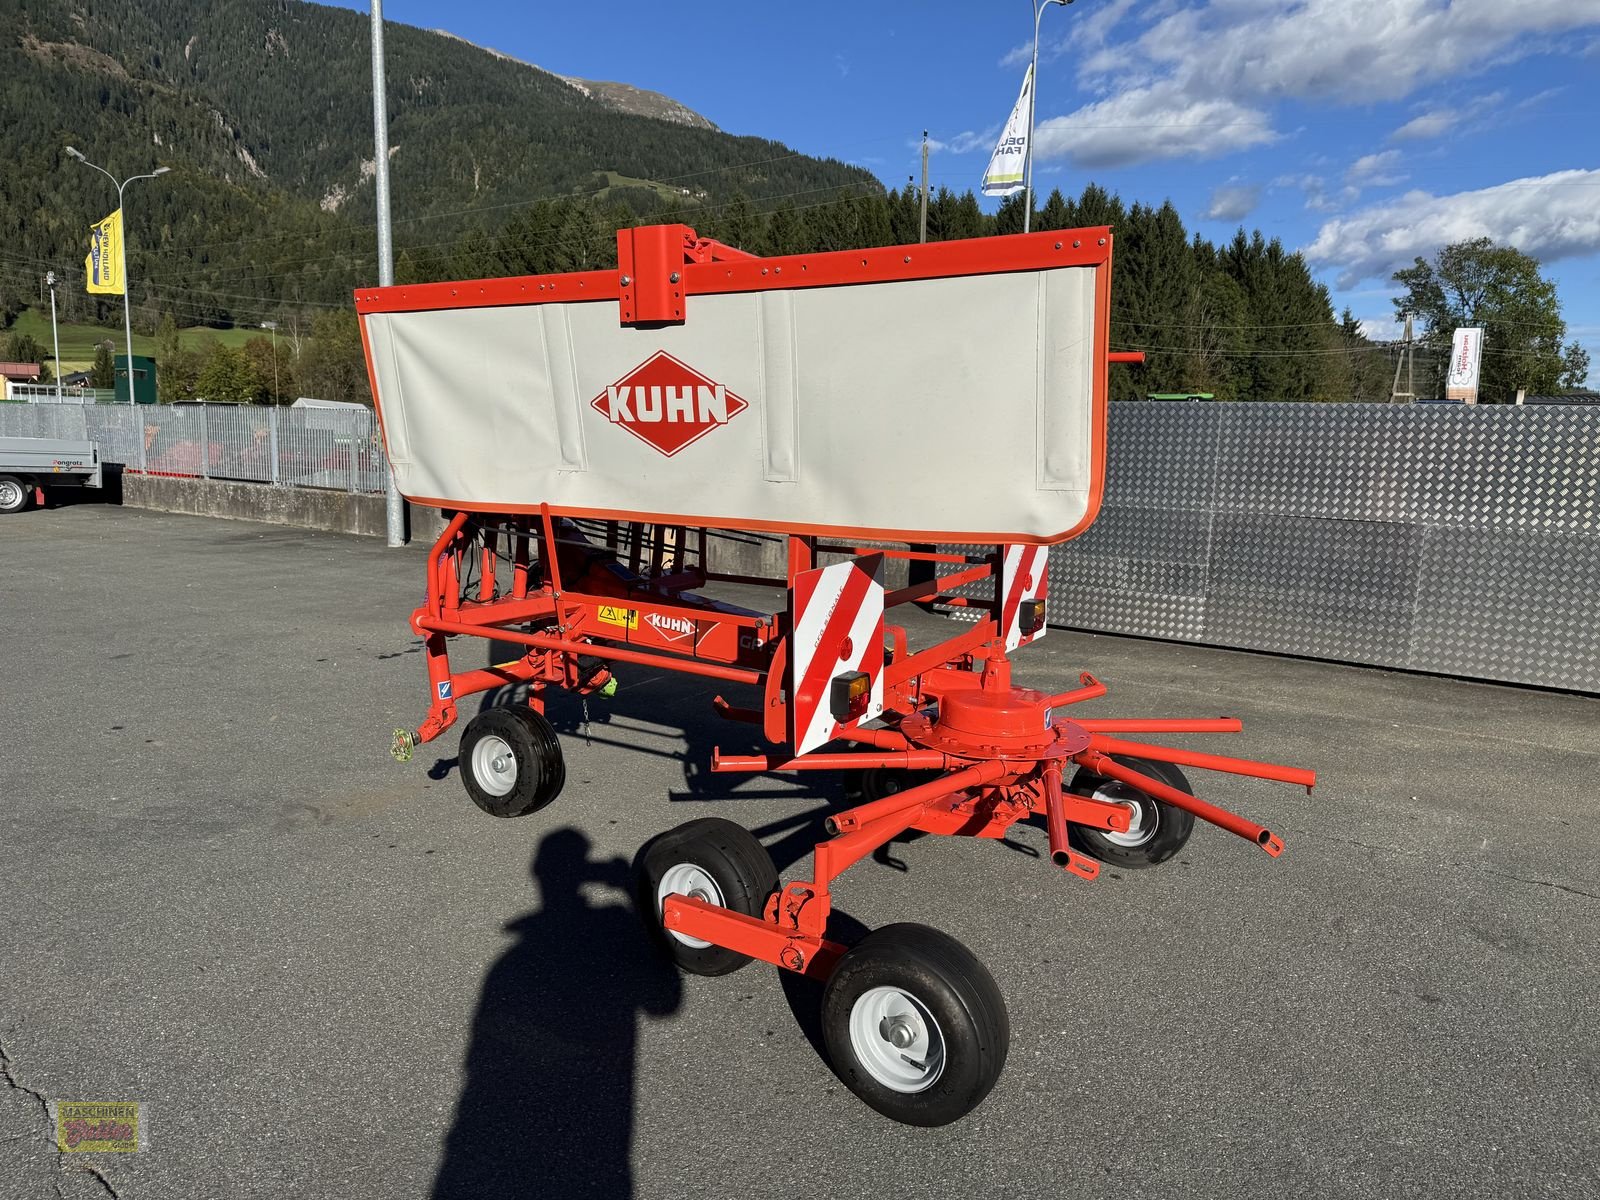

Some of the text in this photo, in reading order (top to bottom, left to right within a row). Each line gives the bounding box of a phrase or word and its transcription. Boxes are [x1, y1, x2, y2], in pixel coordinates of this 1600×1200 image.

[102, 232, 110, 281] NEW HOLLAND
[606, 385, 728, 424] KUHN
[652, 613, 691, 634] KUHN
